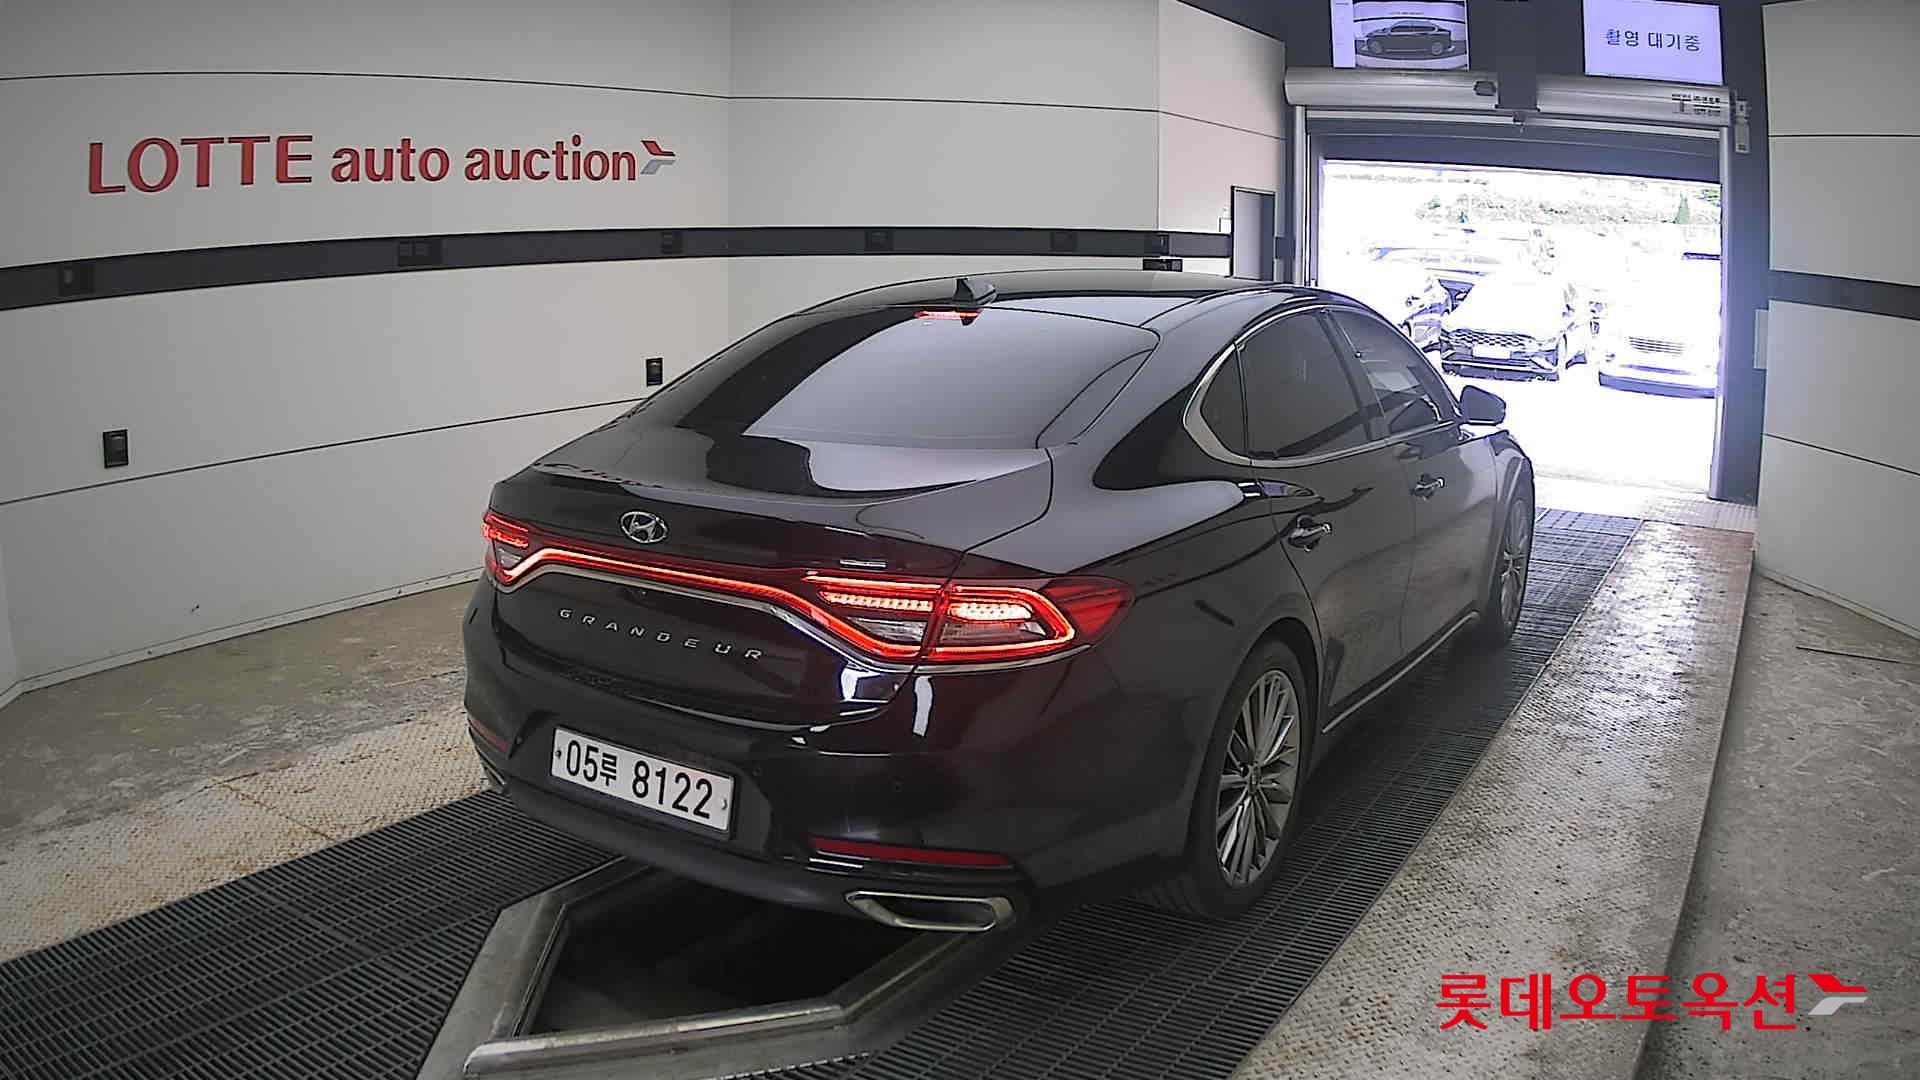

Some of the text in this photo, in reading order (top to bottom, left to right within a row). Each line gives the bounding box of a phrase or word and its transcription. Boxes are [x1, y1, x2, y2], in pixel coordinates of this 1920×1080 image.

[1647, 31, 1701, 52] 대기중
[89, 134, 637, 194] LOTTE auto auction
[559, 608, 763, 660] GRANDEUR
[566, 739, 713, 820] 05루 8122
